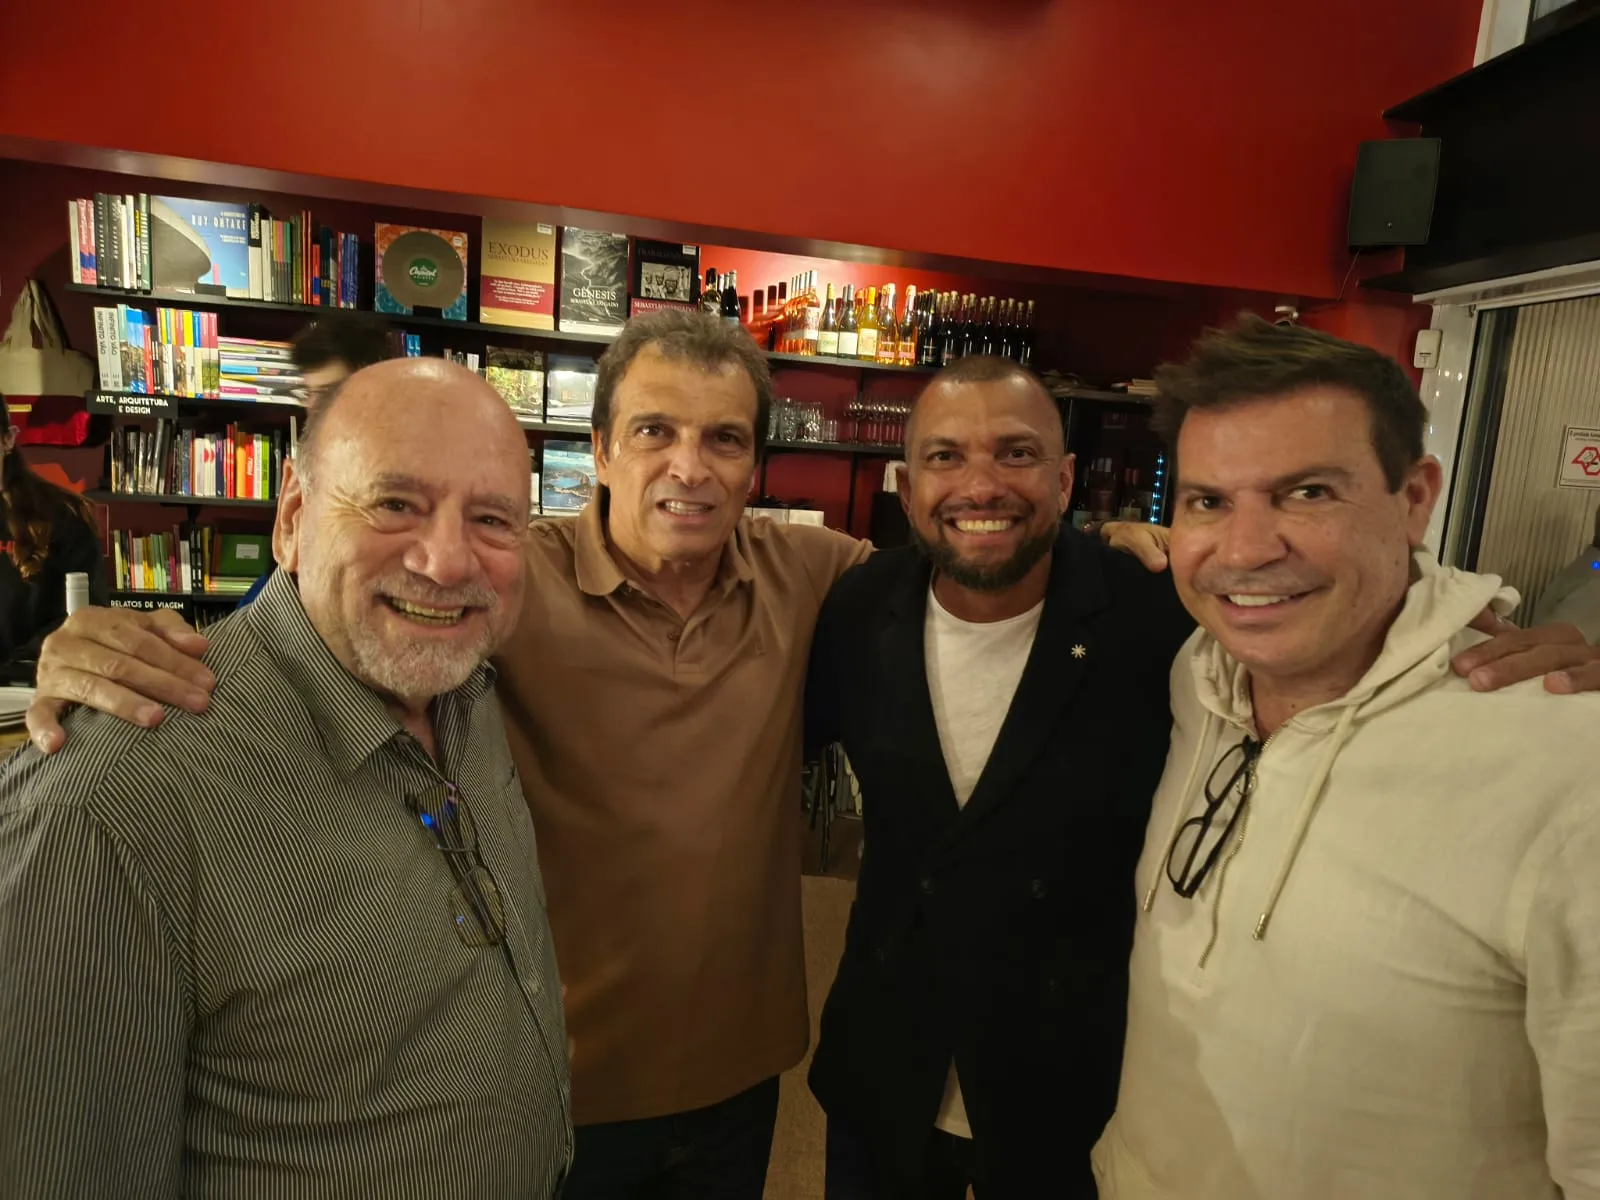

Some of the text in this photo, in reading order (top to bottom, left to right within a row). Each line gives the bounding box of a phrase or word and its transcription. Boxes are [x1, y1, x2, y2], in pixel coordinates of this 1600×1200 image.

[488, 240, 550, 260] EXODUS
[573, 287, 617, 301] GENESIS
[96, 395, 169, 407] ARTE, ARQUITETURA
[118, 405, 151, 414] E DESIGN
[110, 599, 184, 610] RELATOS DE VIAGEM
